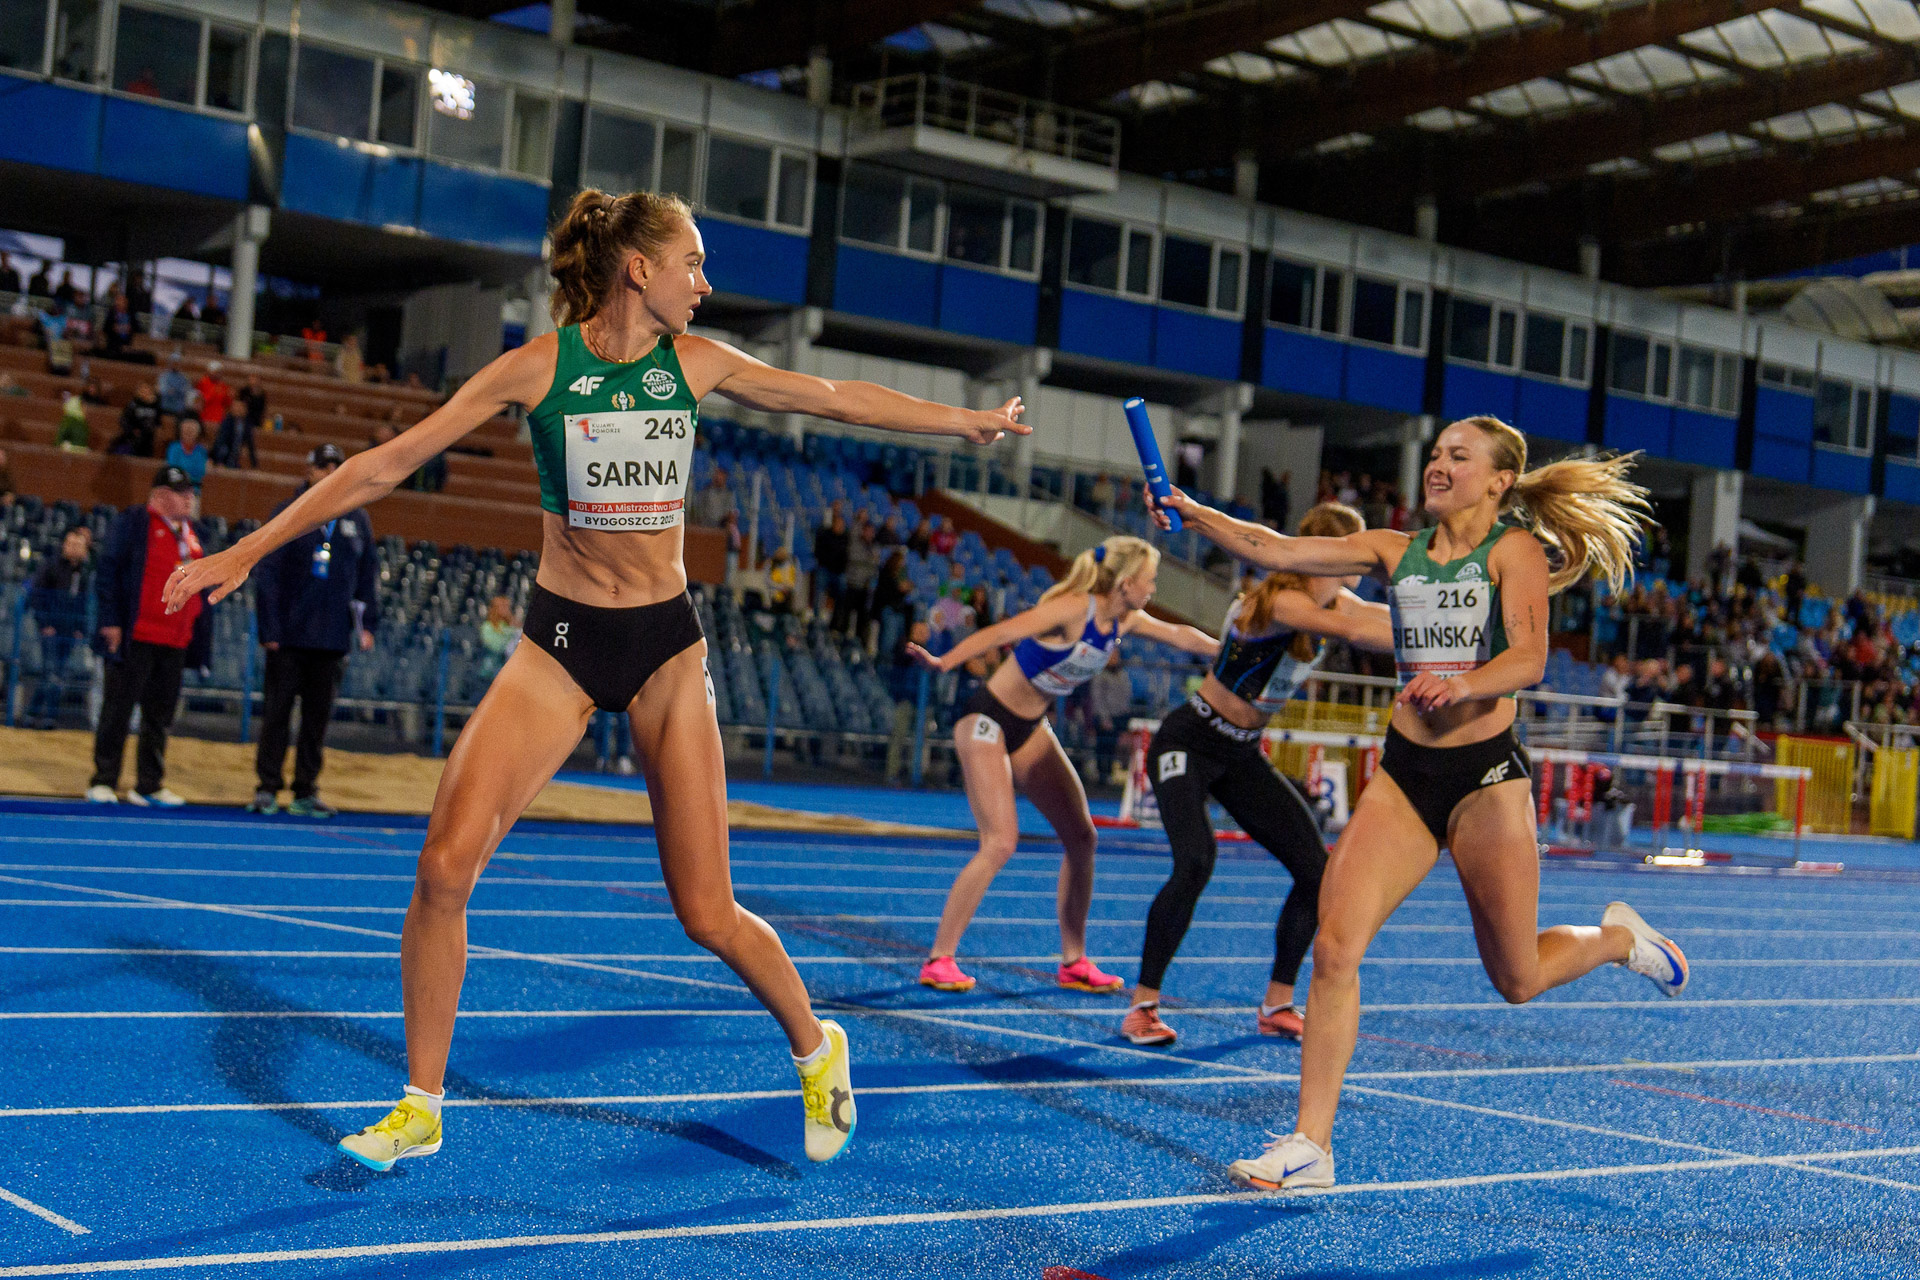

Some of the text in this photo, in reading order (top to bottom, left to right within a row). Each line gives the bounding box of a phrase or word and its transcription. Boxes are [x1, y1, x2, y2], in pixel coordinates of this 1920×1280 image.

[568, 375, 605, 395] 4F
[651, 383, 673, 394] AWF
[644, 417, 687, 440] 243
[586, 460, 679, 487] SARNA
[575, 502, 590, 512] 101.
[591, 504, 614, 512] PZLA
[615, 503, 668, 512] Mistrzostwa
[584, 516, 658, 526] BYDGOSZCZ
[1437, 588, 1478, 609] 216
[1480, 759, 1510, 785] 4F
